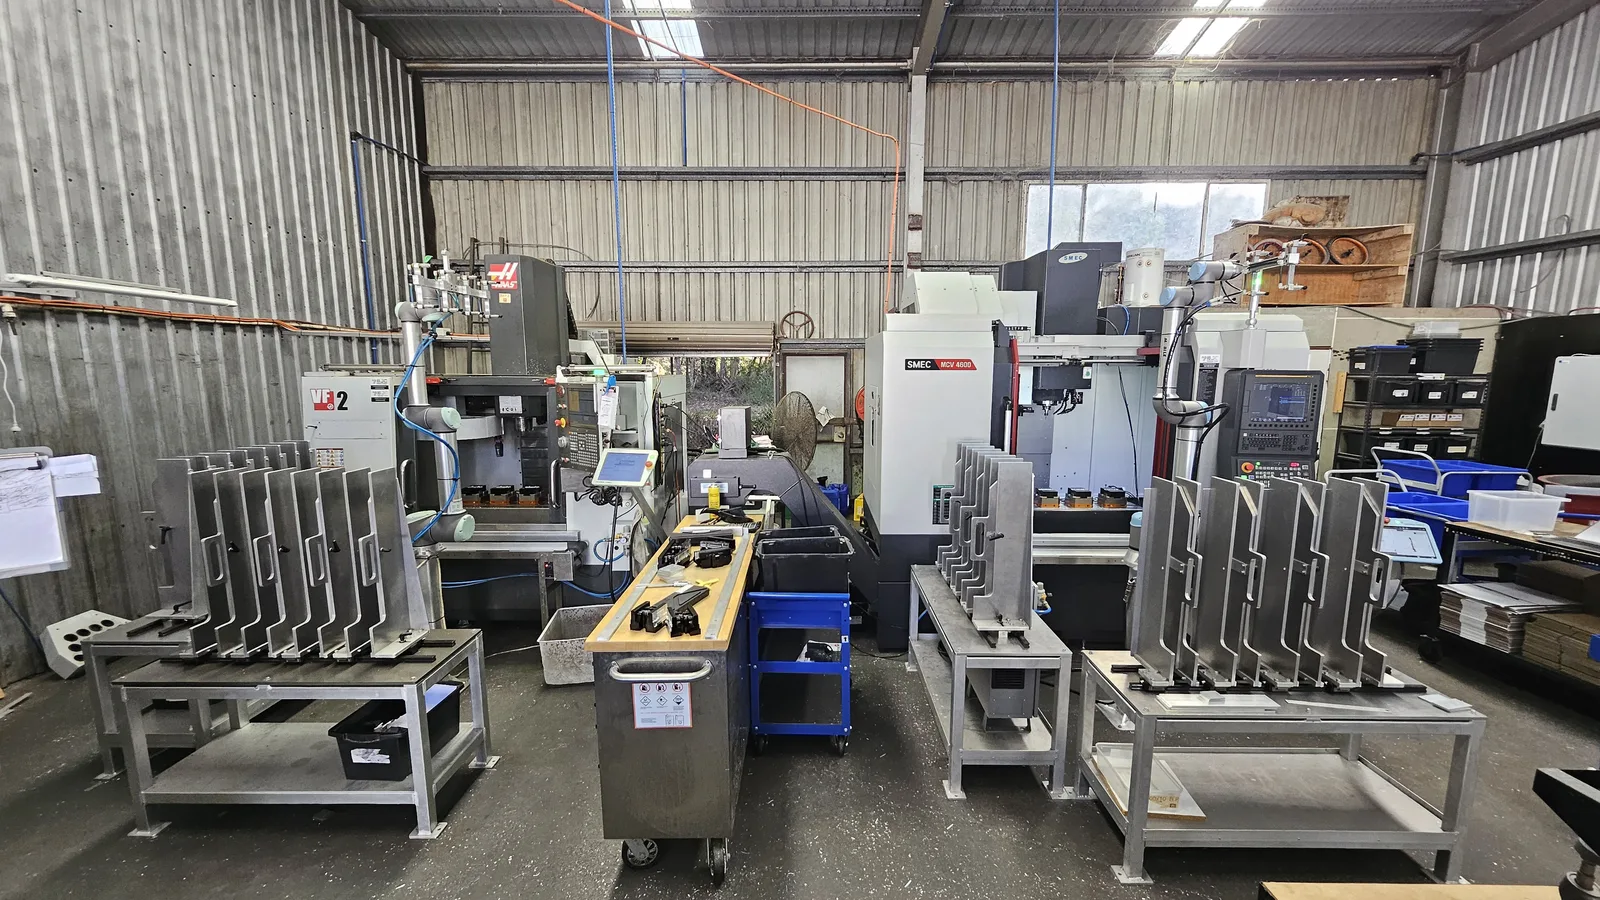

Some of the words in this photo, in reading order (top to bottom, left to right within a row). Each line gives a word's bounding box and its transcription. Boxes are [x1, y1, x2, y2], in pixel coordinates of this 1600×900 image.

[907, 360, 932, 369] SMEC
[310, 388, 331, 403] VF
[336, 390, 349, 410] 2
